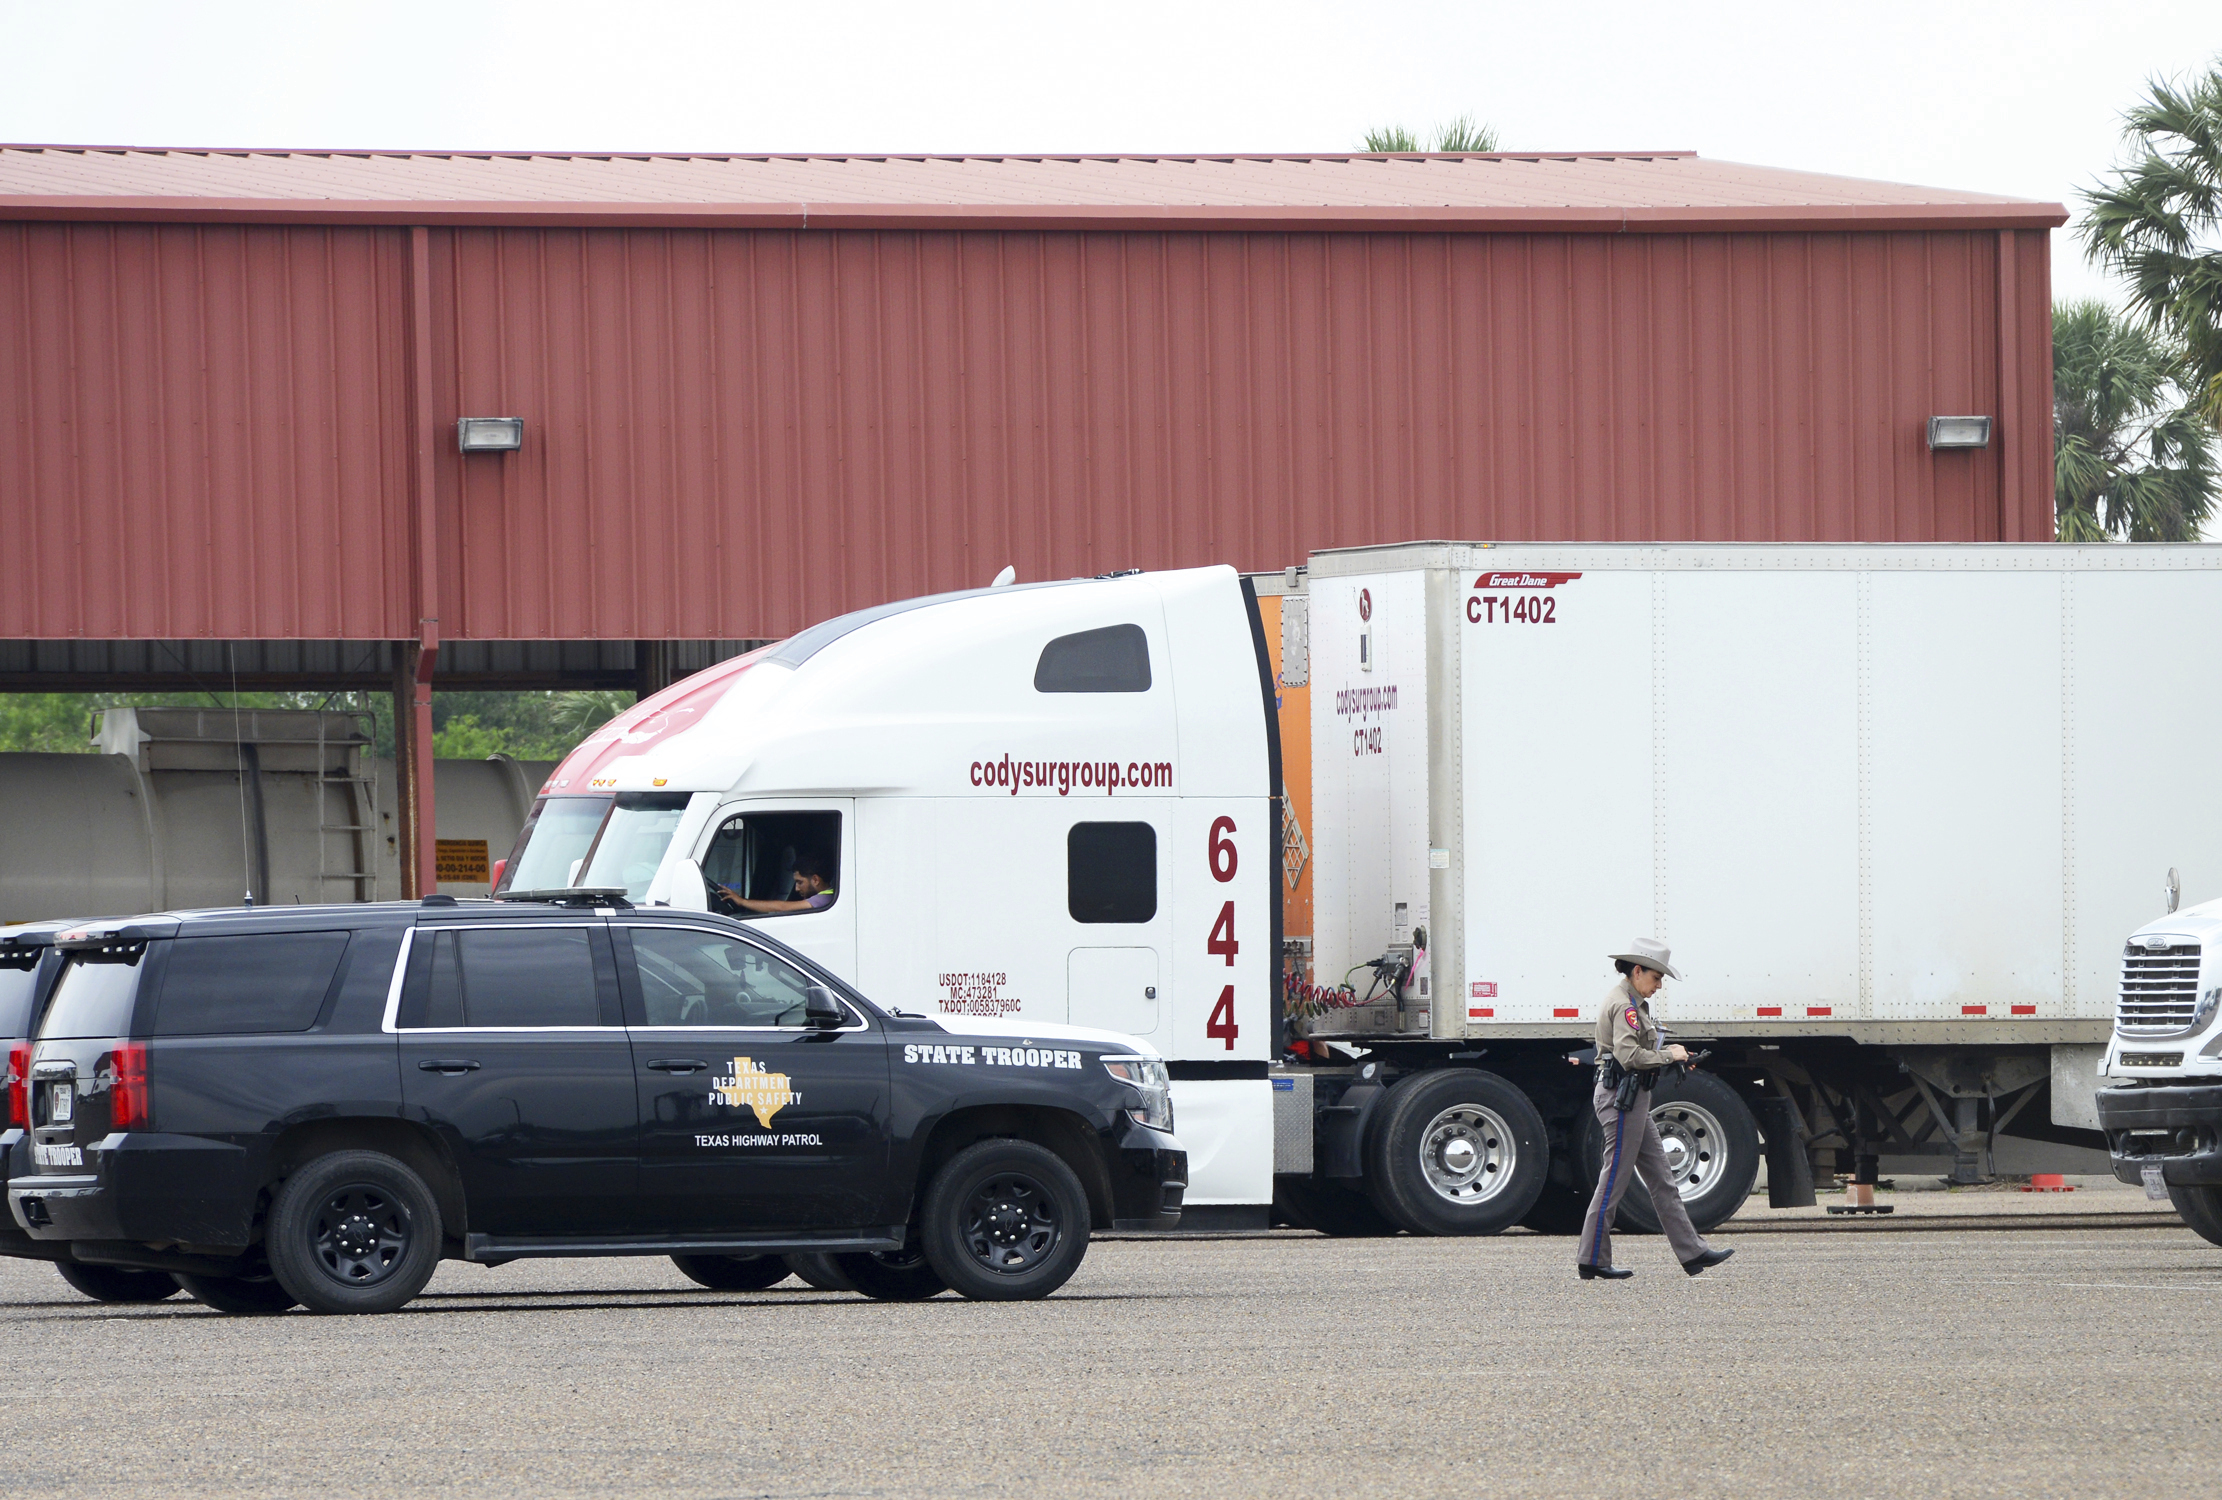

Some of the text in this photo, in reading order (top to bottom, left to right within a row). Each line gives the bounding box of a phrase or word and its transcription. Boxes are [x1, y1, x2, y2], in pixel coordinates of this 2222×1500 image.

[1489, 574, 1548, 587] Great Dane
[1466, 596, 1556, 624] CT1402
[1336, 680, 1398, 724] codysurgroup.com
[1353, 726, 1382, 757] CT1402
[969, 752, 1173, 796] codysurgroup.com
[1206, 815, 1240, 1051] 644
[938, 972, 1007, 986] USDOT:1184128
[950, 986, 997, 999] MC:473281
[938, 998, 1021, 1013] TXDOT:005837960C
[904, 1044, 1082, 1070] STATE TROOPER
[726, 1061, 766, 1075] TEXAS
[712, 1076, 792, 1090] DEPARTMENT
[708, 1092, 802, 1106] PUBLIC SAFETY
[695, 1134, 823, 1147] TEXAS HIGHWAY PATROL
[48, 1146, 83, 1166] TROOPER
